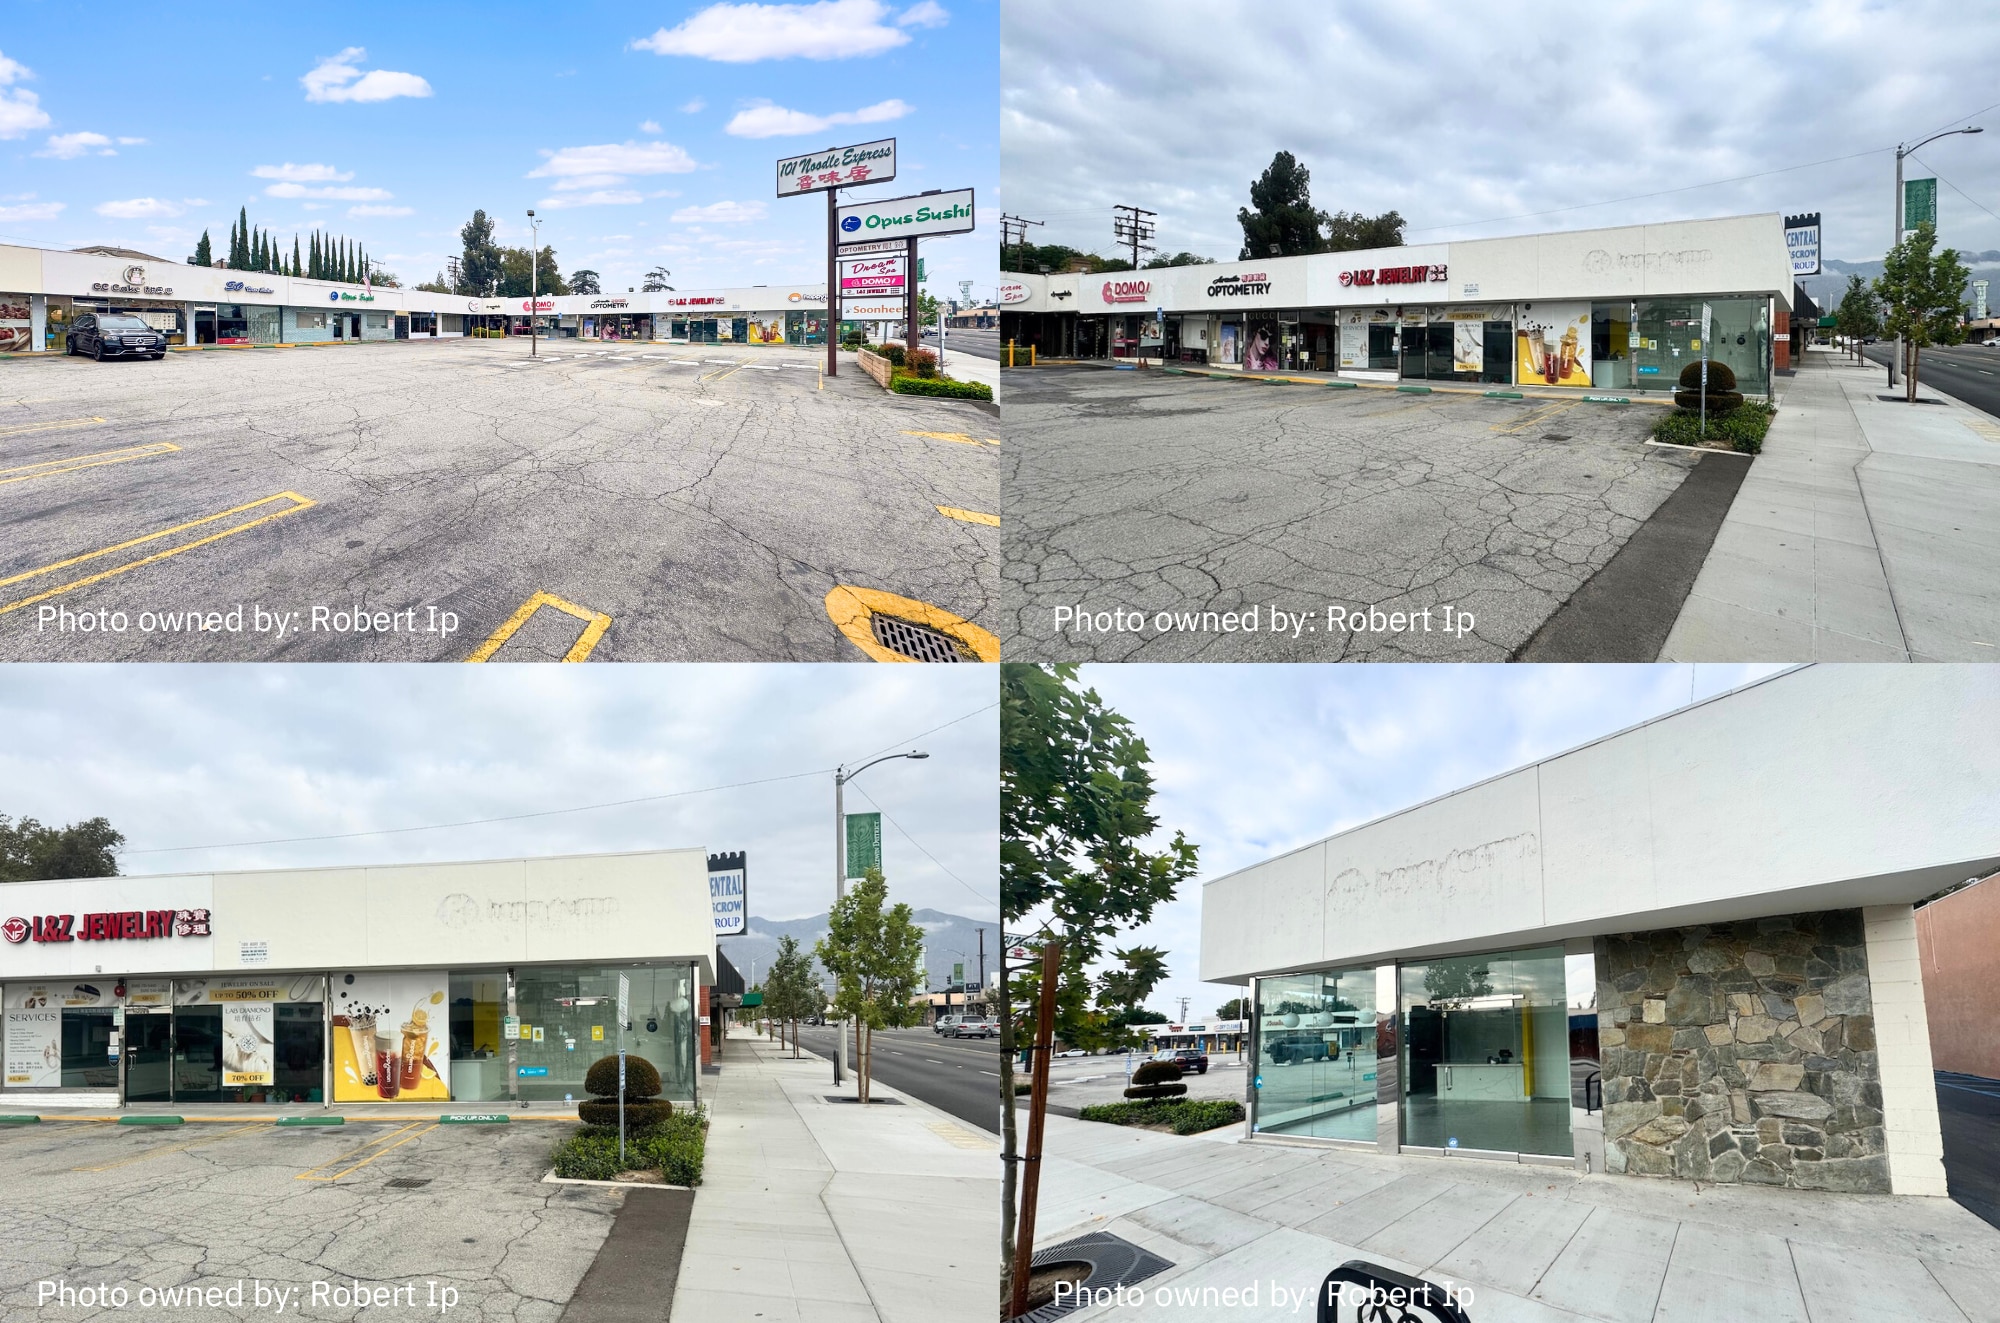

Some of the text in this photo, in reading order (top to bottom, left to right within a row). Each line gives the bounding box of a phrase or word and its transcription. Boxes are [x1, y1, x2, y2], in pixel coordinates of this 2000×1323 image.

[780, 145, 893, 178] 101 Noodle Express
[865, 203, 972, 230] Opus Sushi
[1787, 230, 1818, 248] CENTRAL
[839, 243, 881, 254] OPTOMETRY
[1789, 249, 1818, 259] SCROW
[851, 259, 897, 275] Dream
[877, 266, 897, 275] Spa
[1793, 261, 1816, 270] ROUP
[1353, 265, 1429, 286] L&Z JEWELRY
[1207, 283, 1272, 298] OPTOMETRY
[1004, 292, 1024, 301] Spa
[853, 304, 903, 314] Soonhee
[710, 875, 743, 897] ENTRAL
[32, 909, 176, 943] L&Z JEWELRY
[714, 916, 741, 928] ROUP
[235, 990, 257, 999] 50%
[258, 990, 279, 999] OFF
[9, 1012, 57, 1022] SERVICES
[231, 1074, 248, 1082] 70%
